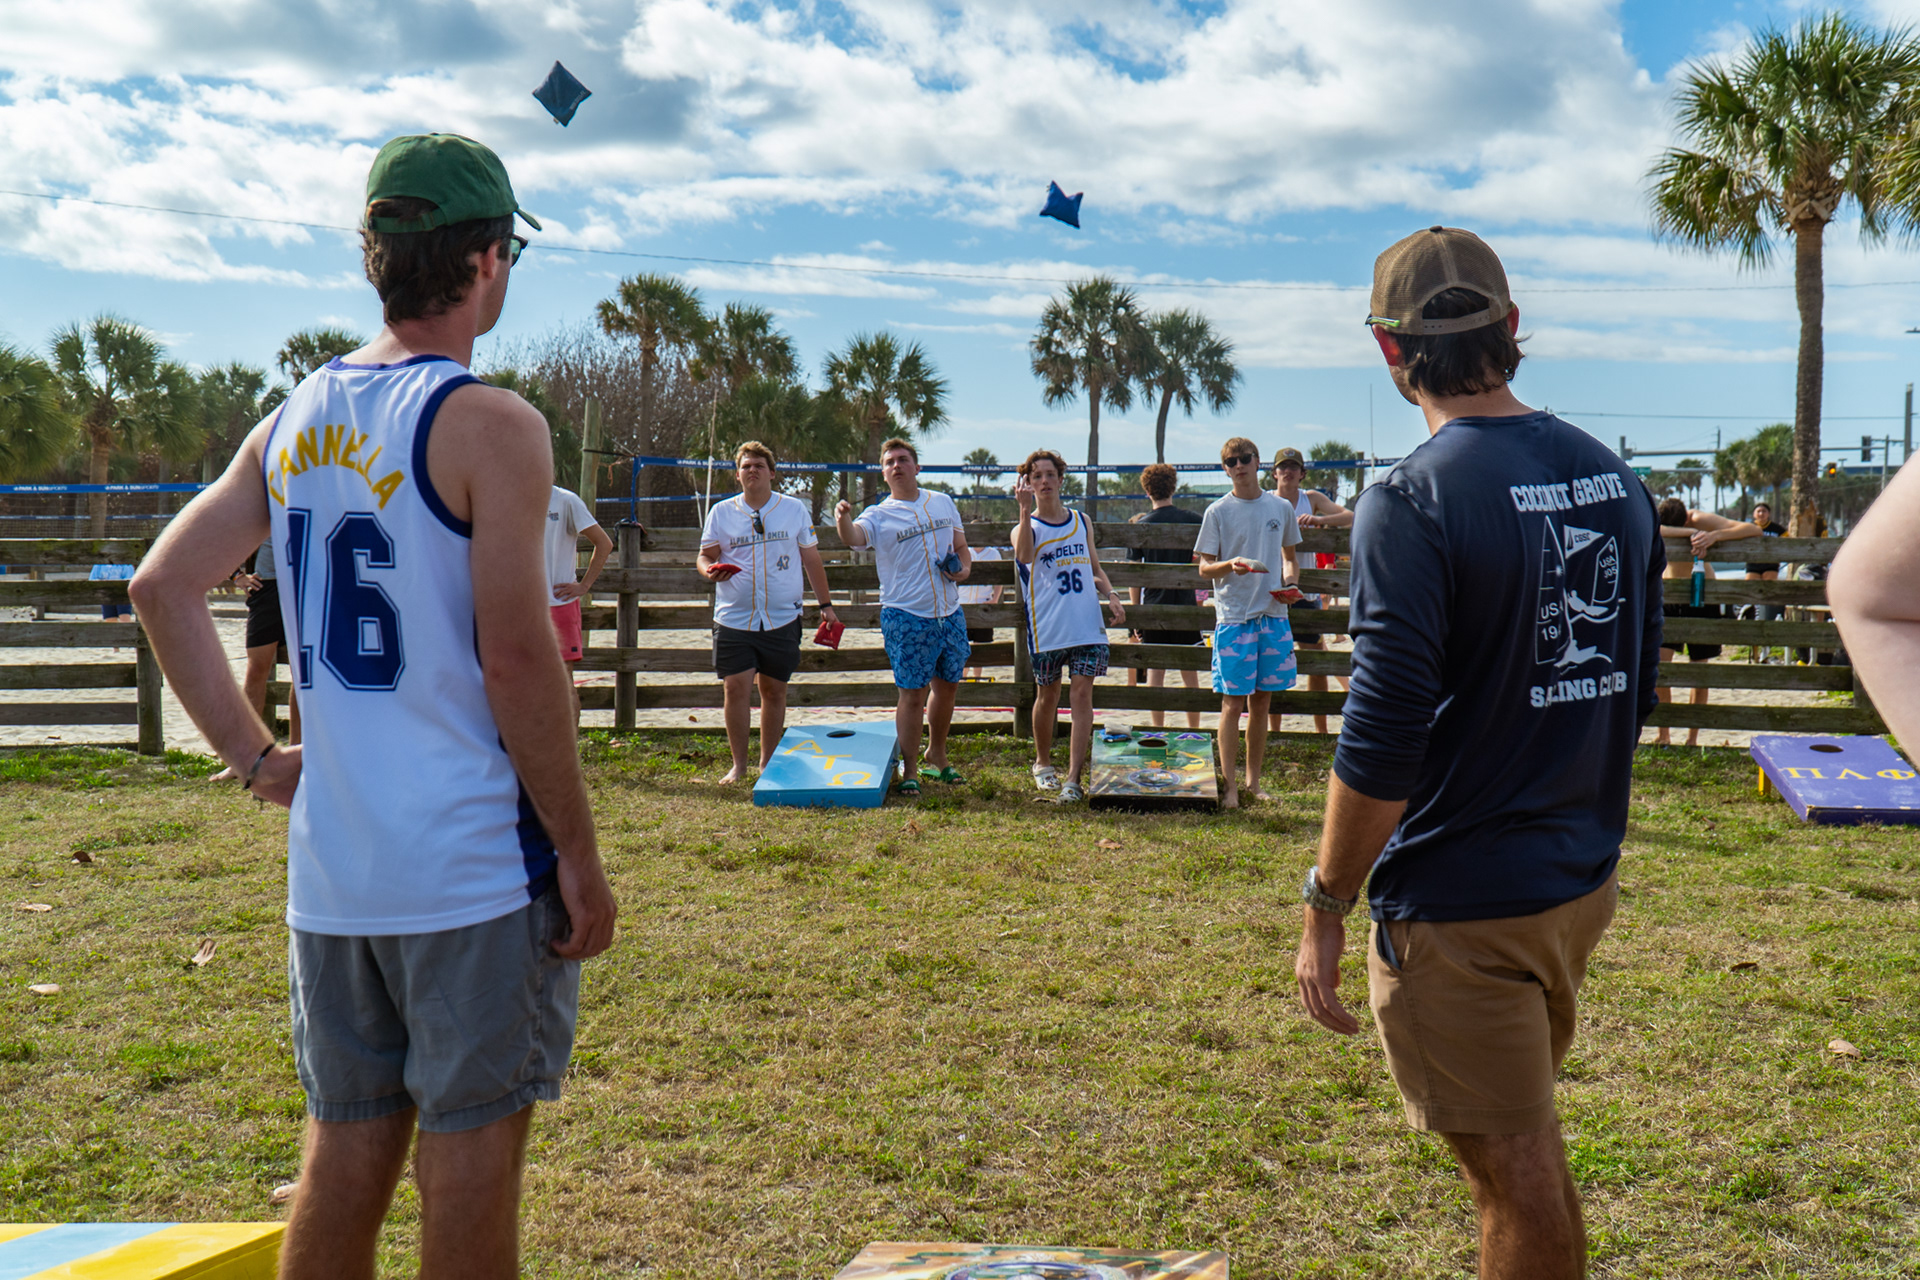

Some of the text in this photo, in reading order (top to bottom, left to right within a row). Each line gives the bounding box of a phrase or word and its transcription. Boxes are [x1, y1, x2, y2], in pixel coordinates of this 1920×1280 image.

[1510, 472, 1627, 512] COCONUT GROVE
[730, 535, 750, 546] ALPHA
[767, 531, 789, 540] OMEGA
[896, 526, 918, 541] ALPHA
[1056, 544, 1084, 557] DELTA
[1056, 559, 1071, 567] TAU
[1056, 568, 1084, 596] 36
[1541, 600, 1564, 620] US
[1541, 623, 1562, 641] 19
